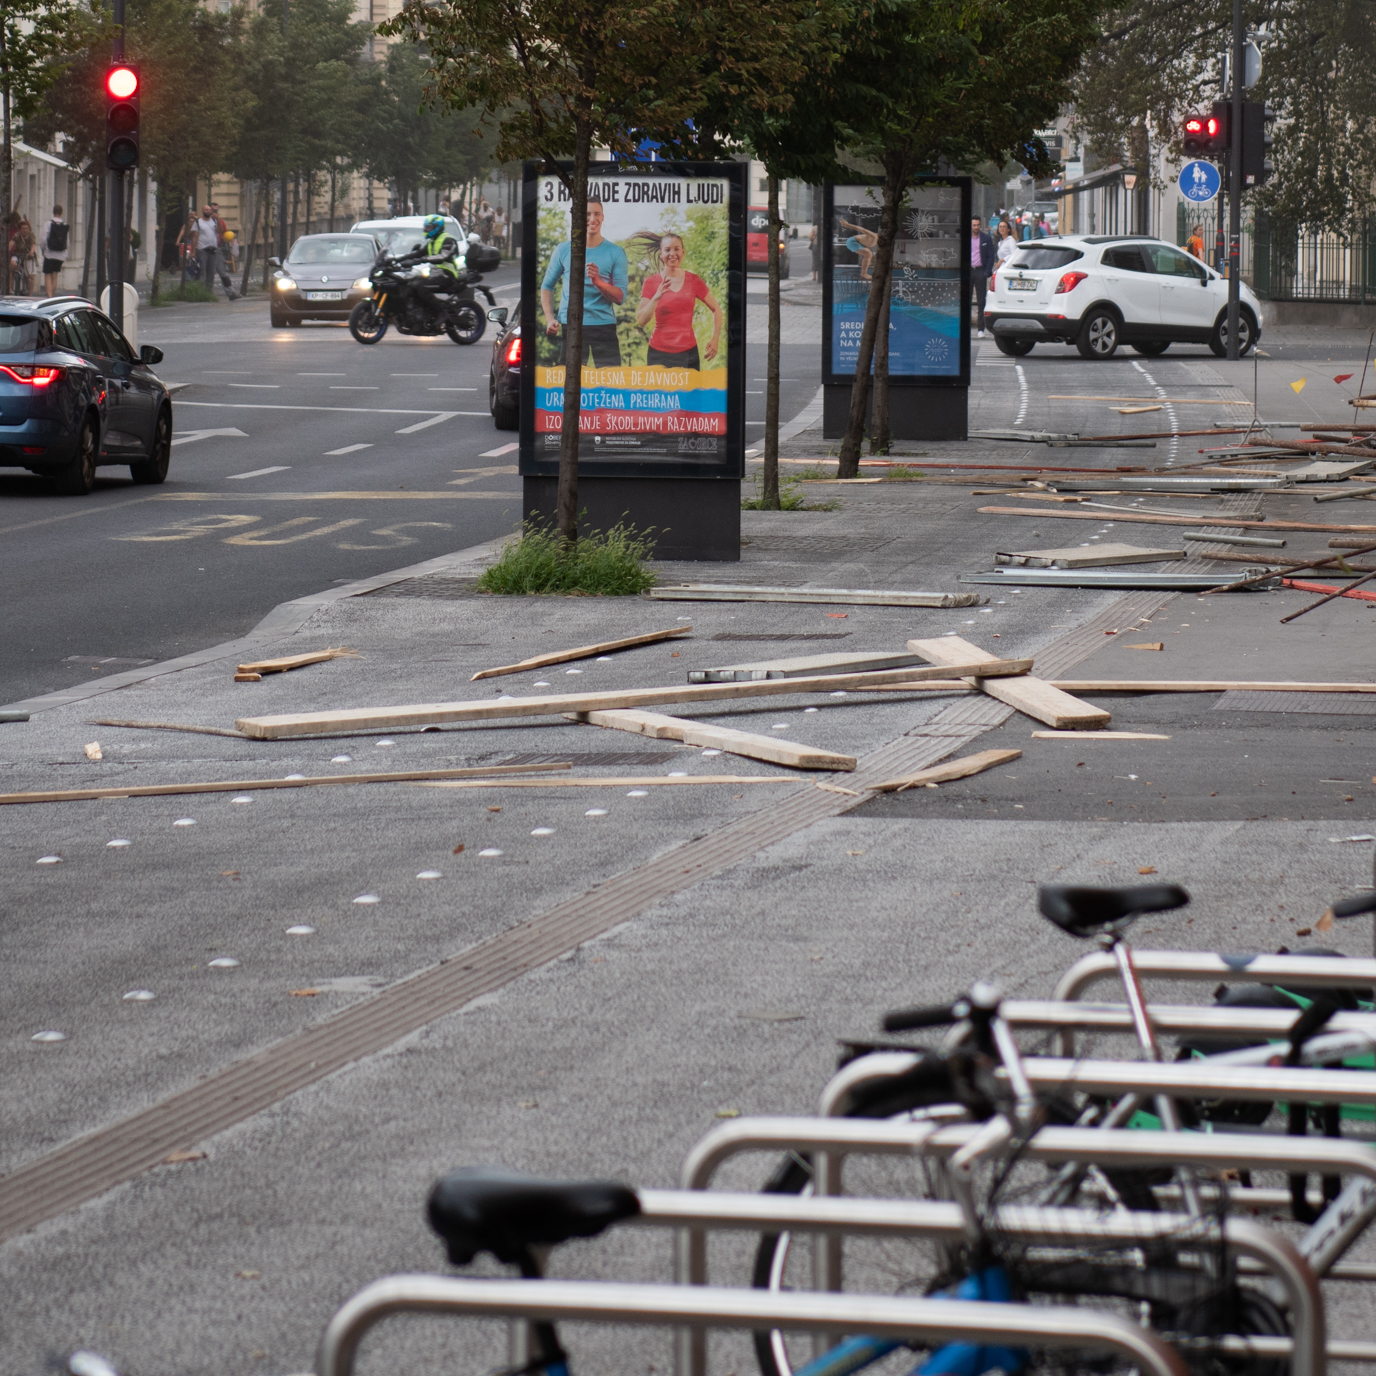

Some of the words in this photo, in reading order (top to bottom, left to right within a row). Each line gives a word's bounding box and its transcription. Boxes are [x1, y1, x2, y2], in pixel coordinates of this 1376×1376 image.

[544, 181, 554, 203] 3
[624, 182, 681, 203] ZDRAVIH
[686, 183, 723, 205] LJUDI
[751, 215, 768, 229] dp
[546, 369, 564, 384] RED
[584, 371, 625, 386] TELESNA
[631, 371, 690, 386] DEJAVNOST
[545, 390, 625, 408] URAOTEŽENA
[630, 393, 681, 409] PREHRANA
[545, 415, 601, 430] IZOANJE
[606, 413, 663, 431] ŠKODLJIVIM
[667, 417, 719, 432] RAZVADAM
[108, 514, 454, 551] BUS
